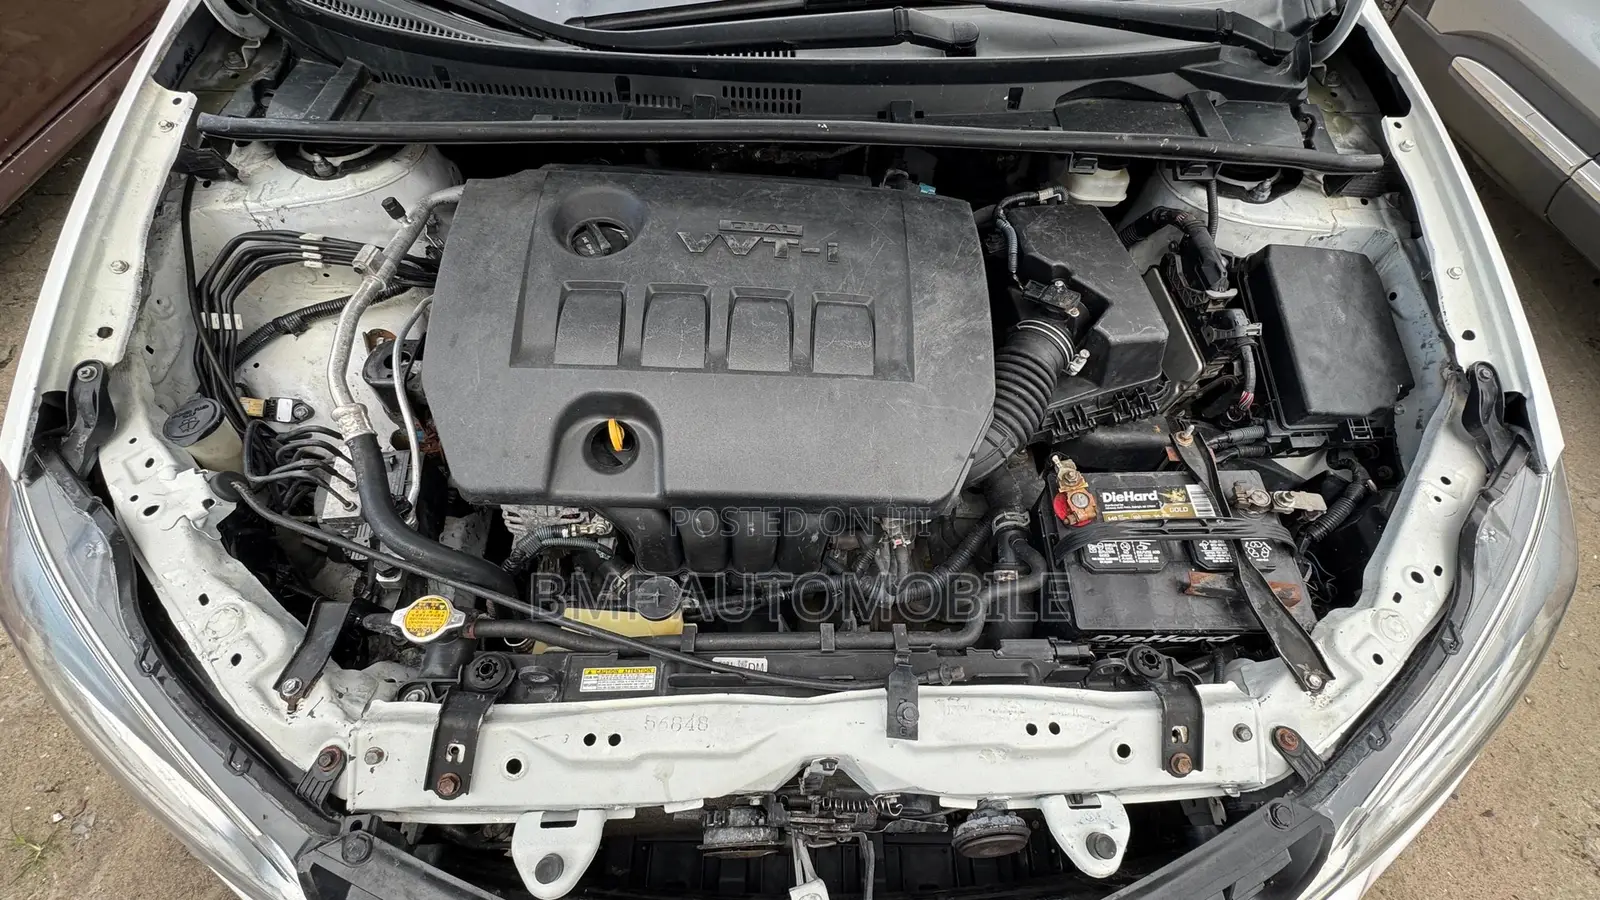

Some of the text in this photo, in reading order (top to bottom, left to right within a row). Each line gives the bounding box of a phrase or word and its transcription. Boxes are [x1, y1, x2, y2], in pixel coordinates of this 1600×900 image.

[729, 220, 799, 234] DUAL
[1101, 490, 1159, 503] DieHard
[1089, 634, 1240, 643] DieHard
[644, 713, 709, 732] 56848
